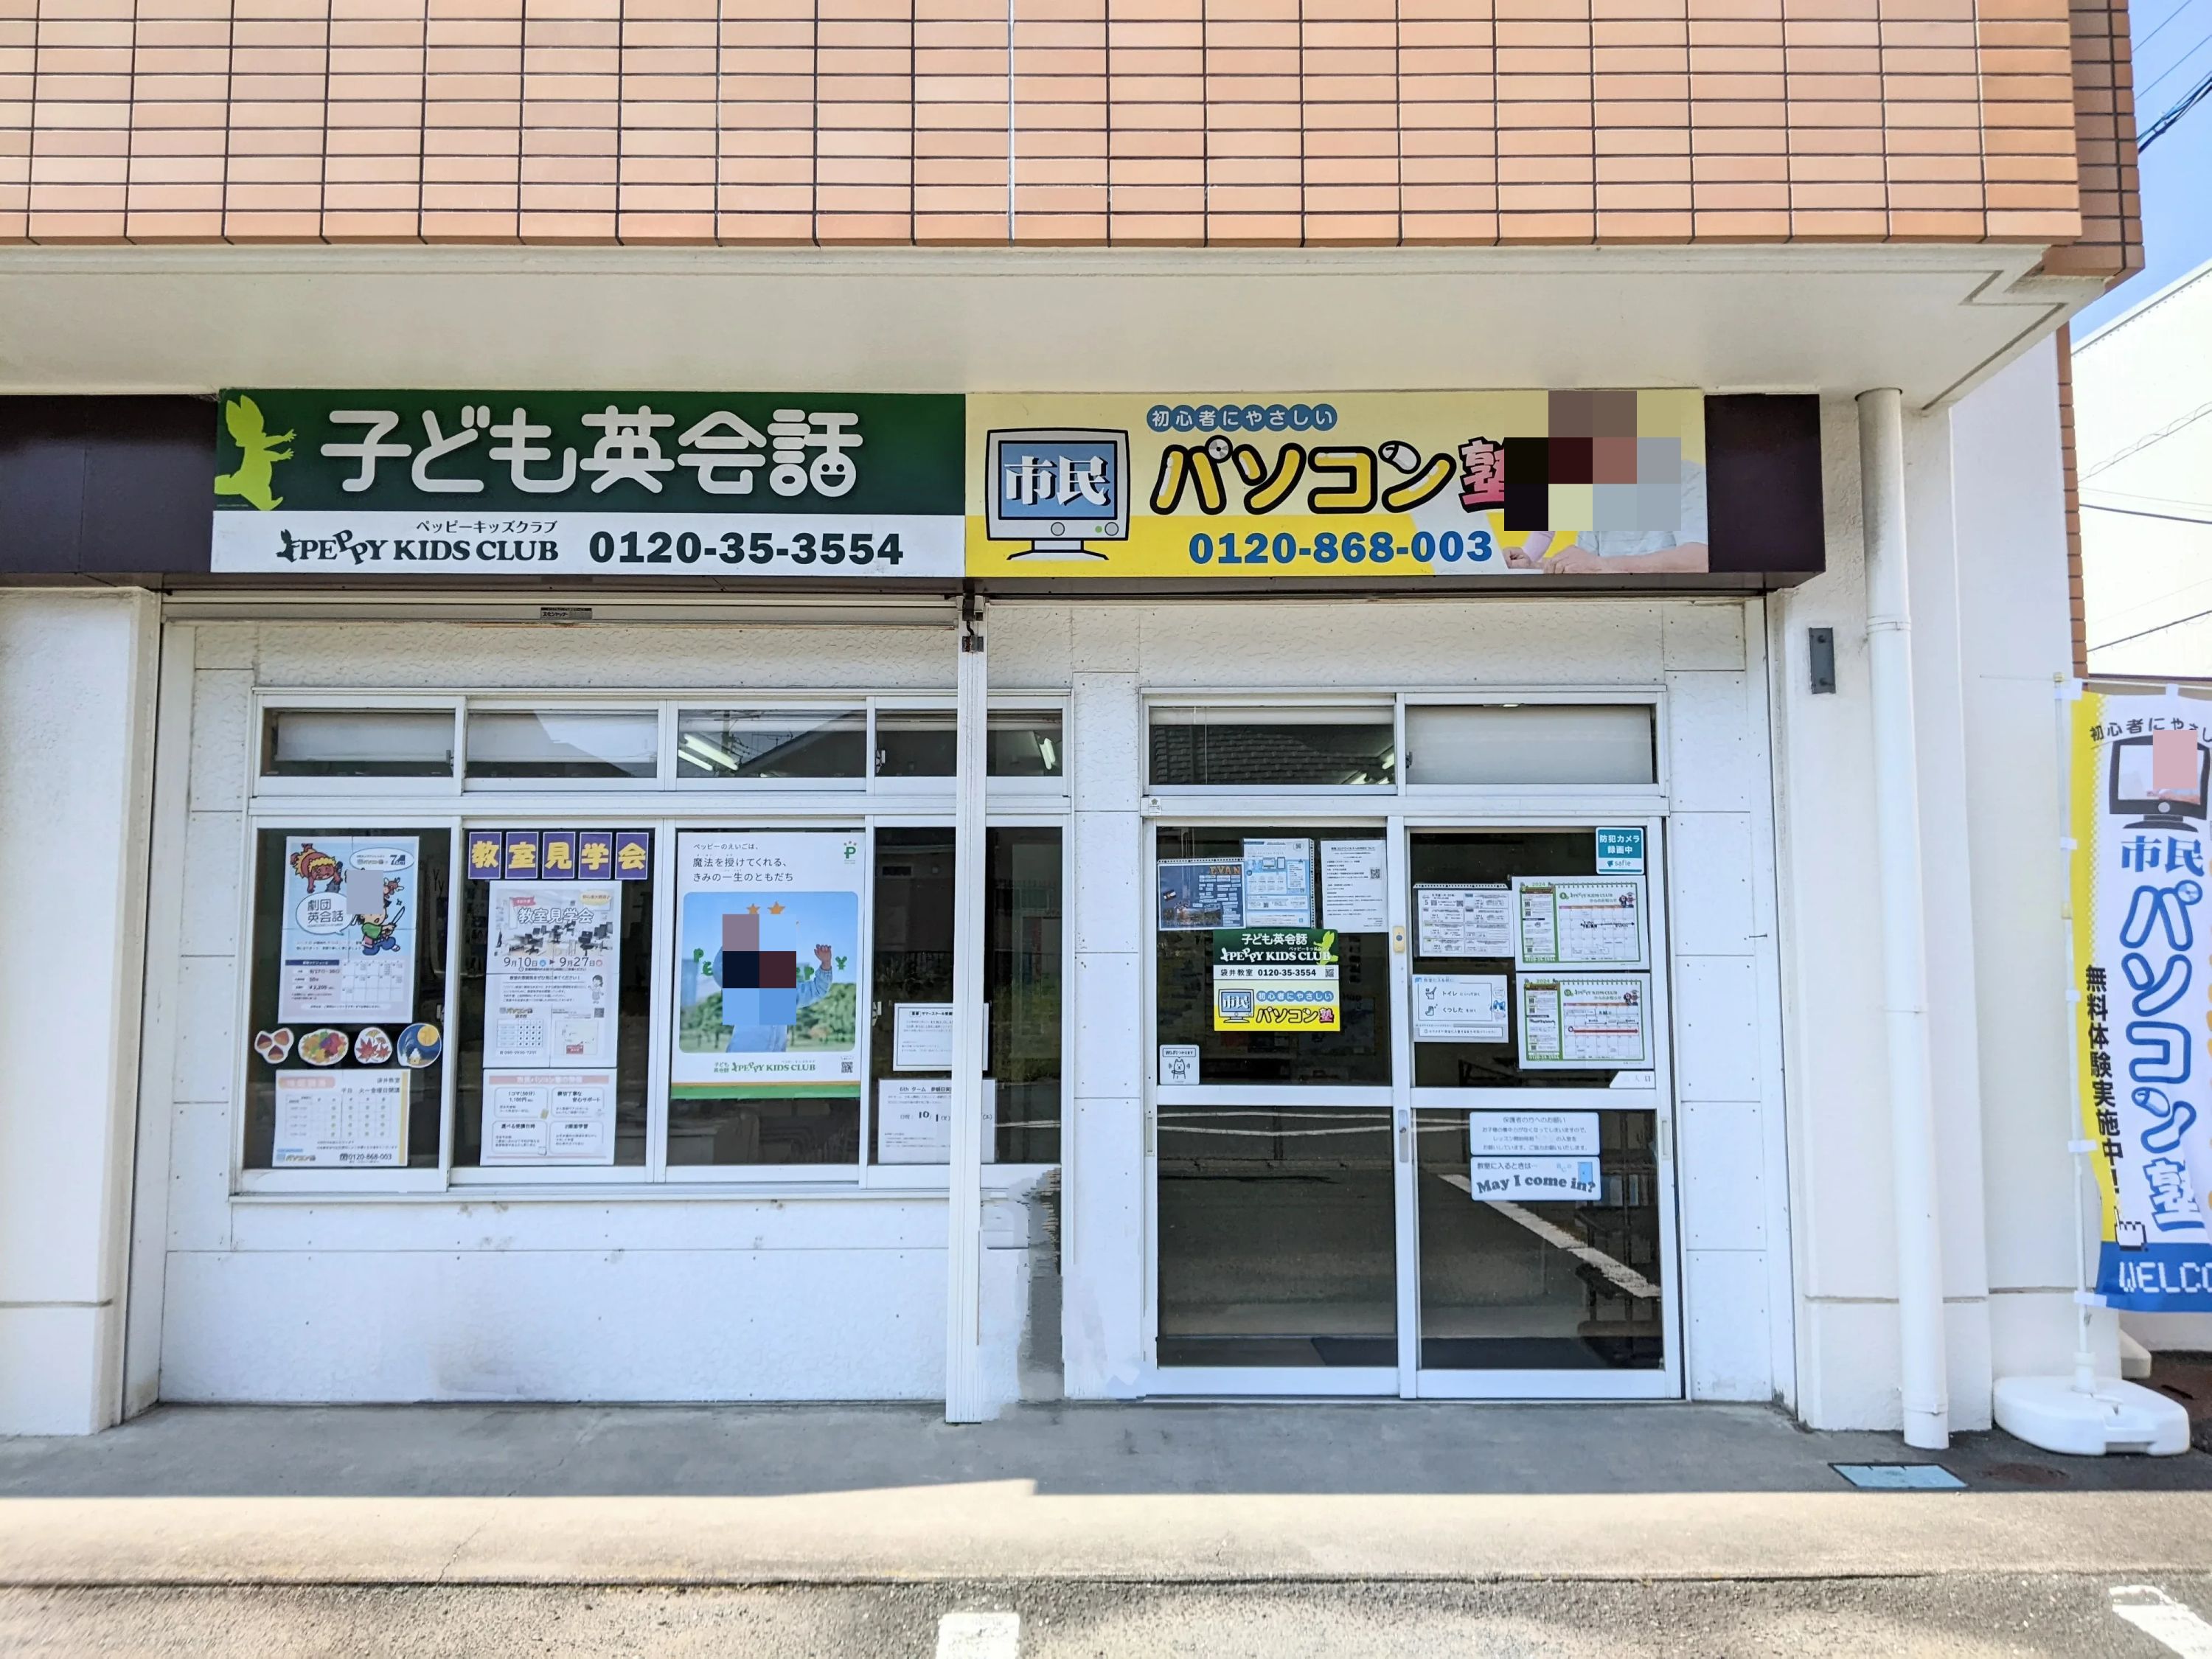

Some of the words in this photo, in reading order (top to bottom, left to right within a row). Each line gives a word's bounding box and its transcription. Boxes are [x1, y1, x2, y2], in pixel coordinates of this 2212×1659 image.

[1151, 407, 1335, 431] 初心者にやさしい
[320, 405, 863, 498] 子ども英会話
[1003, 455, 1112, 508] 市民
[417, 520, 559, 535] ペッピーキッズクラブ
[298, 529, 389, 565] PEPPY
[393, 540, 470, 561] KIDS
[476, 540, 559, 561] CLUB
[589, 532, 903, 565] 0120-35-3554
[1189, 532, 1493, 565] 0120-868-003
[2089, 717, 2212, 743] 初心者にやし
[1599, 834, 1640, 843] 防犯カメラ
[471, 840, 647, 871] 教室見学会
[1607, 846, 1633, 854] 録画中
[2121, 834, 2205, 877] 市民
[693, 858, 787, 868] 魔法を授けてくれる、
[1209, 866, 1241, 874] EVAN
[693, 872, 793, 882] きみの一生のともだち
[307, 899, 331, 911] 劇団
[307, 910, 344, 923] 英会話
[518, 908, 594, 925] 教室見学会
[1242, 933, 1308, 945] 子ども英会話
[504, 956, 538, 967] 9月10日
[559, 956, 595, 967] 9月27日
[1231, 947, 1264, 963] PEPPY
[1266, 951, 1296, 961] KIDS
[1298, 951, 1331, 961] CLUB
[1220, 969, 1253, 977] 袋井教室
[1223, 995, 1250, 1009] 市民
[1256, 1006, 1335, 1023] パソコン塾
[1476, 1178, 1510, 1194] May
[1513, 1175, 1521, 1187] I
[1524, 1175, 1568, 1188] come
[1571, 1178, 1596, 1193] in?
